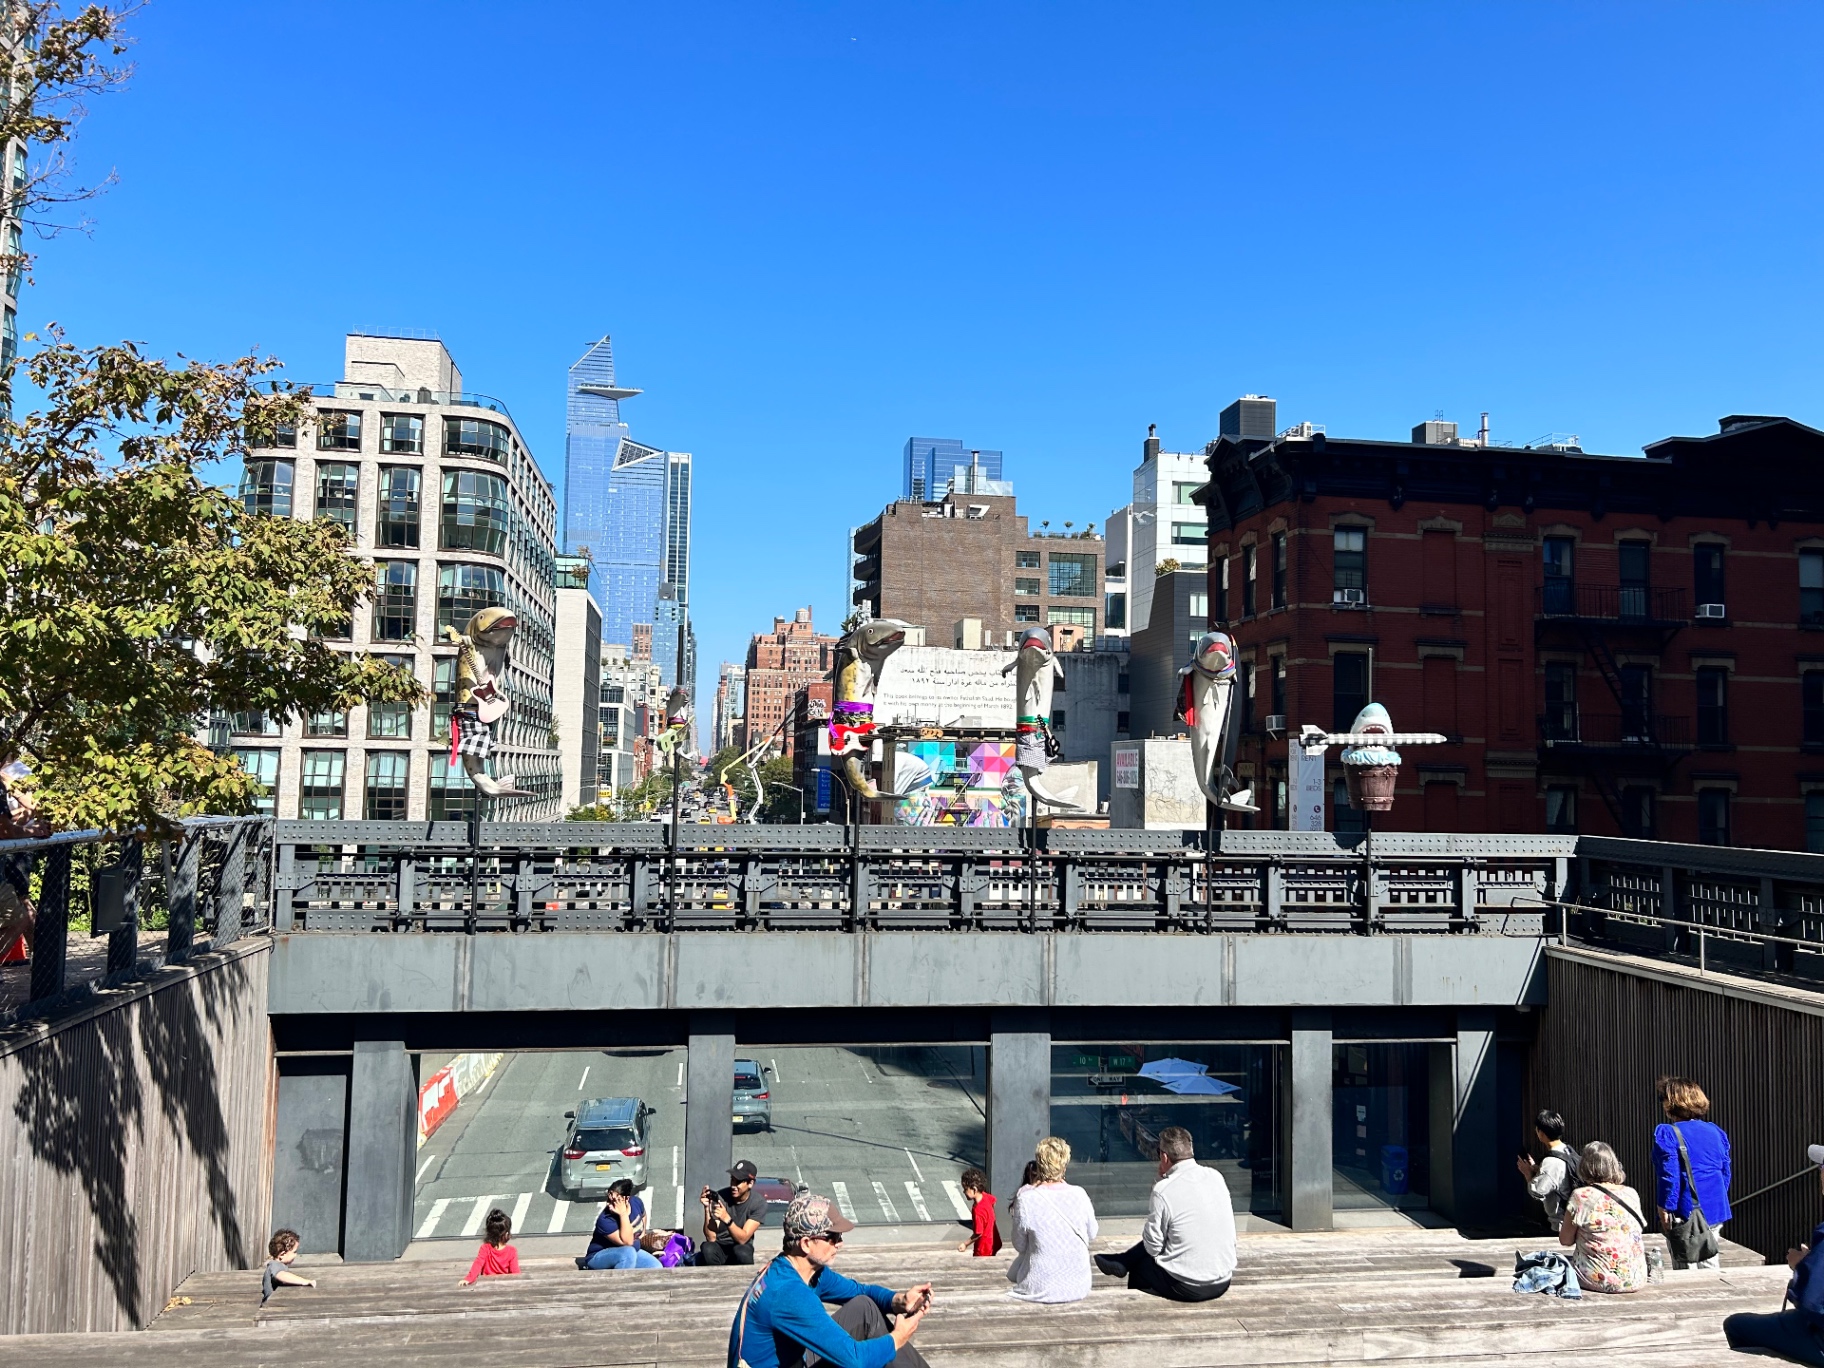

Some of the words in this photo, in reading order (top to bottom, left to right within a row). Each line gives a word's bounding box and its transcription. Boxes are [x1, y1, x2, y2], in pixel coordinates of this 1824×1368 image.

[1079, 1056, 1087, 1065] 10
[1112, 1058, 1118, 1066] W
[1119, 1057, 1126, 1066] 17
